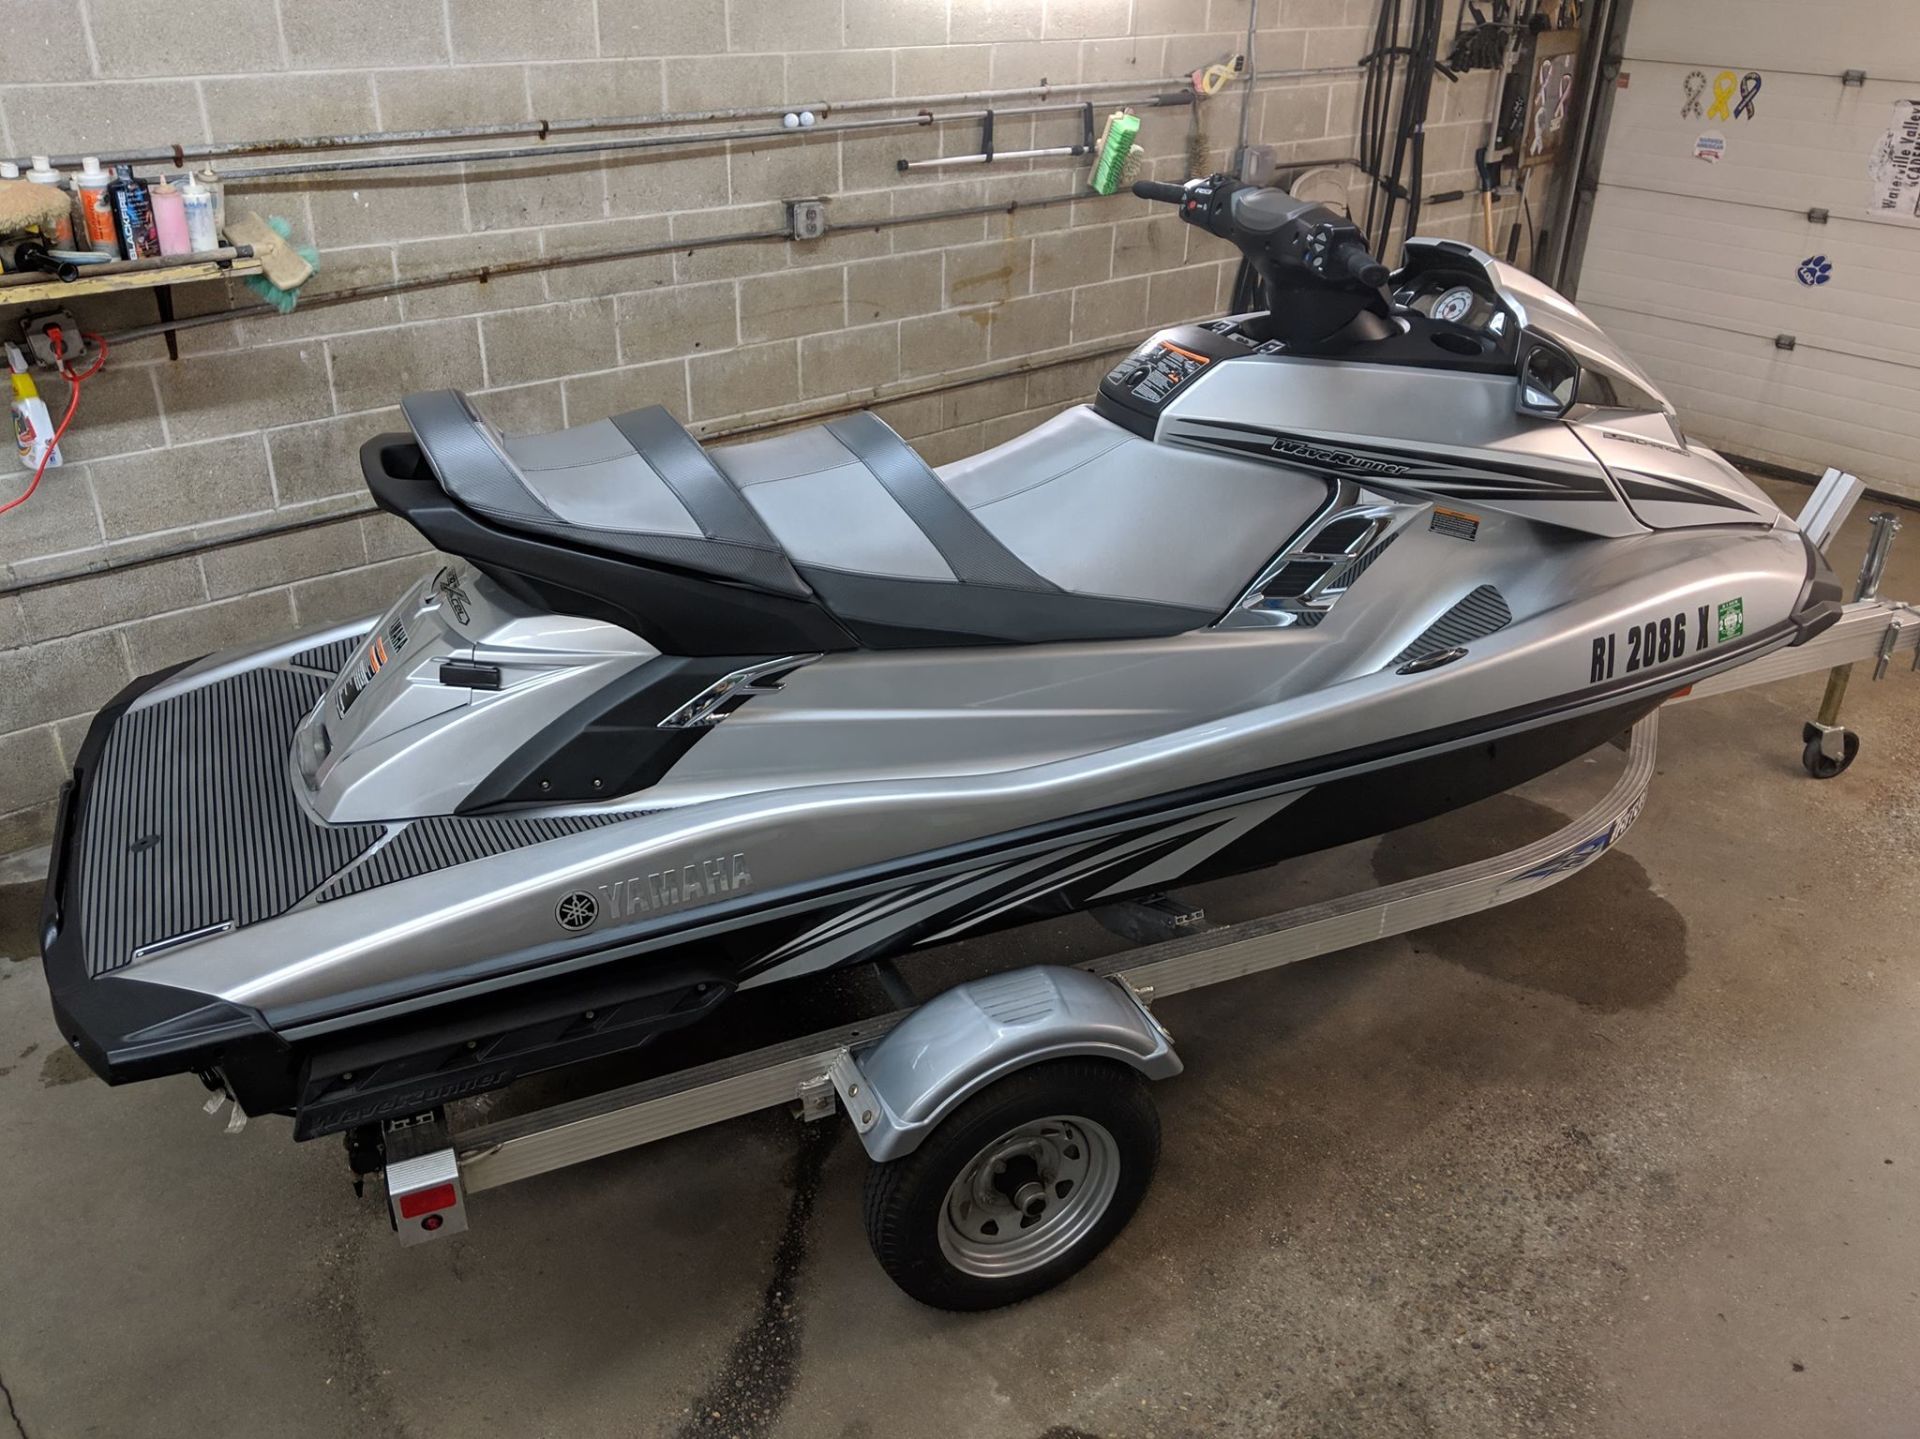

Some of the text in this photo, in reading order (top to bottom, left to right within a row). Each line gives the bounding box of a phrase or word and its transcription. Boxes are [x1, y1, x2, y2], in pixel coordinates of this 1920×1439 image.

[117, 191, 137, 260] BLACKFIRE
[1272, 438, 1410, 475] WaveRunner
[1590, 605, 1710, 684] RI 2086 X
[599, 852, 752, 919] YAMAHA
